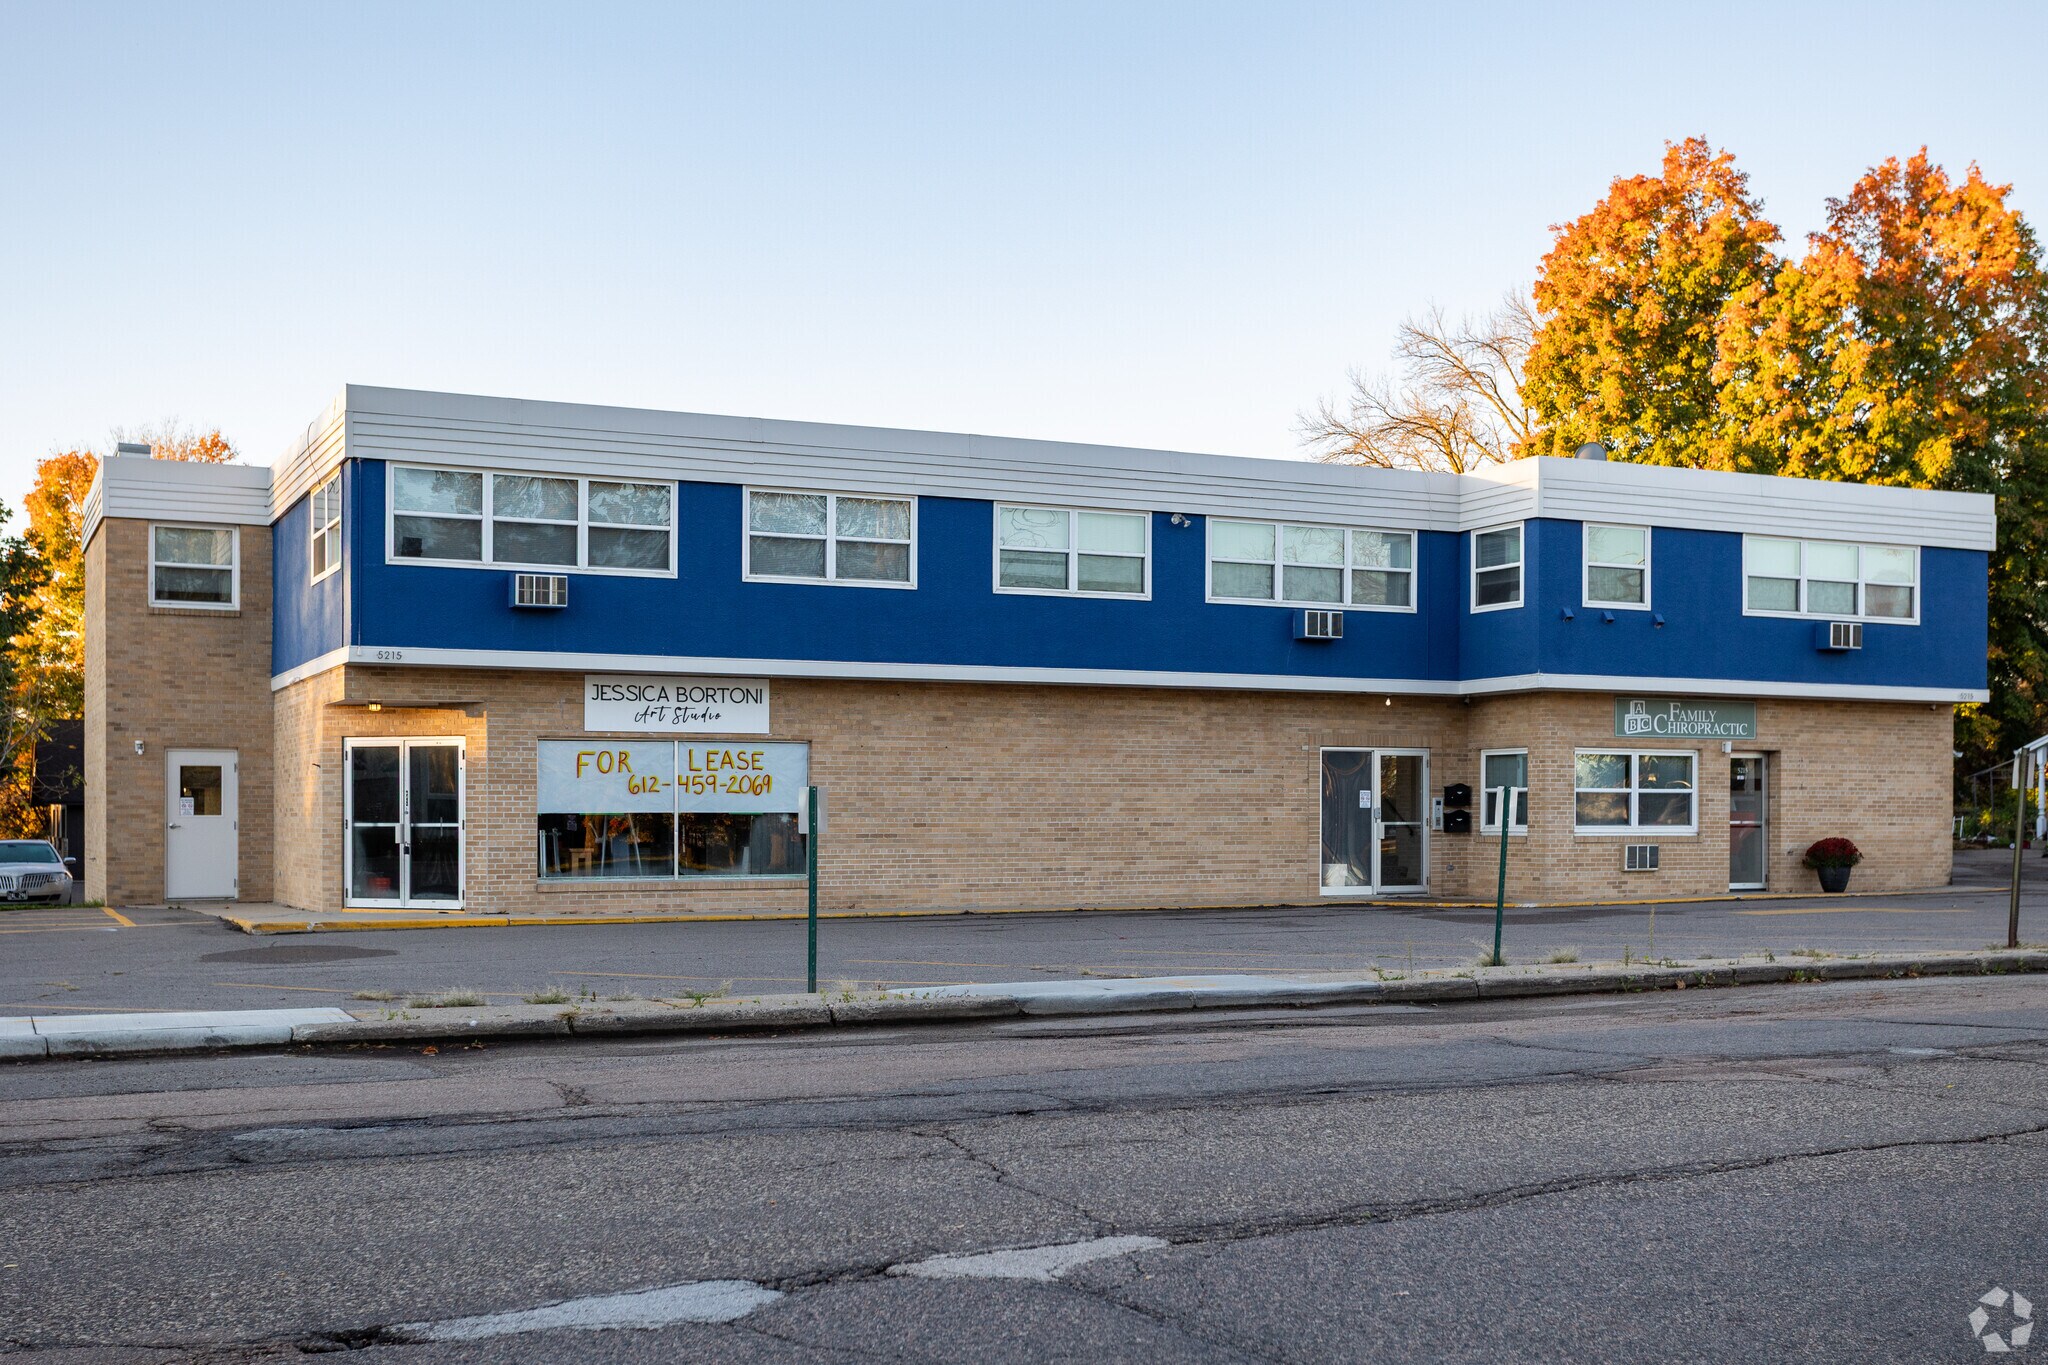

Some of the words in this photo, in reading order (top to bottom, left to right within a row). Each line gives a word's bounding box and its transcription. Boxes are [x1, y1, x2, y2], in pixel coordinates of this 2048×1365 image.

[377, 650, 402, 660] 5215
[591, 683, 670, 702] JESSICA
[676, 687, 763, 704] BORTONI
[634, 705, 672, 724] Art
[671, 706, 722, 725] Studio
[577, 750, 632, 778] FOR
[688, 749, 765, 772] LEASE
